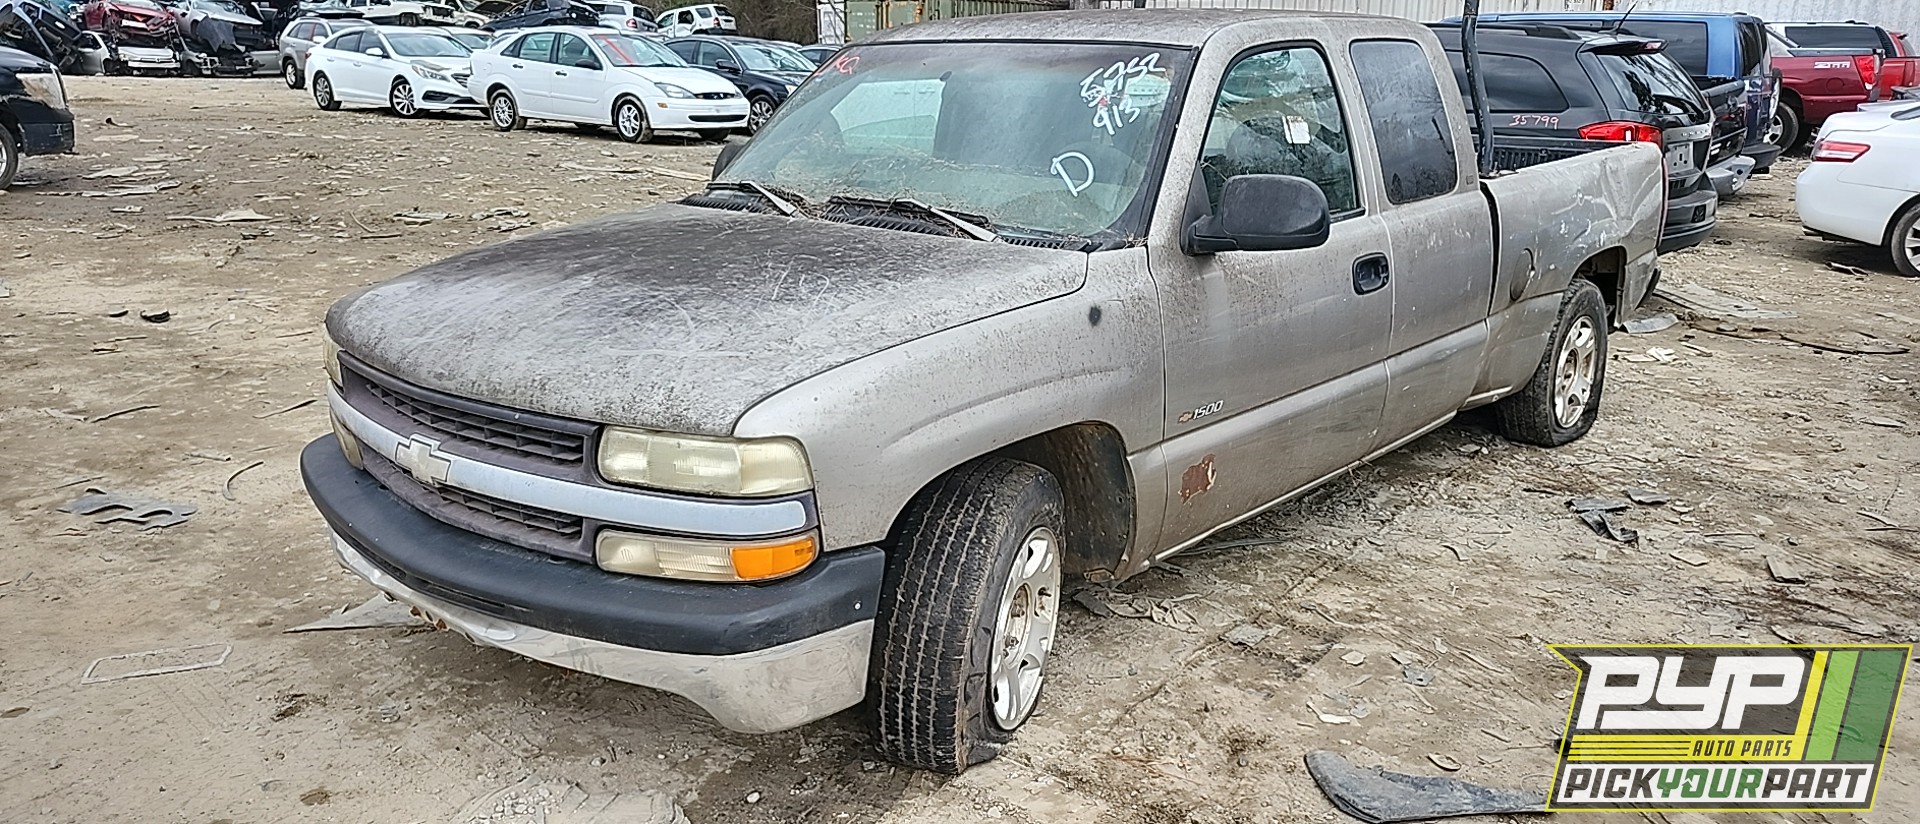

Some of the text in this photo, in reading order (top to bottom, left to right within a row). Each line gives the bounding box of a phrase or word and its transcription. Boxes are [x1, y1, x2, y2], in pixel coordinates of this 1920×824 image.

[1092, 95, 1141, 135] 913
[1050, 151, 1094, 197] D
[1193, 400, 1224, 420] 1500
